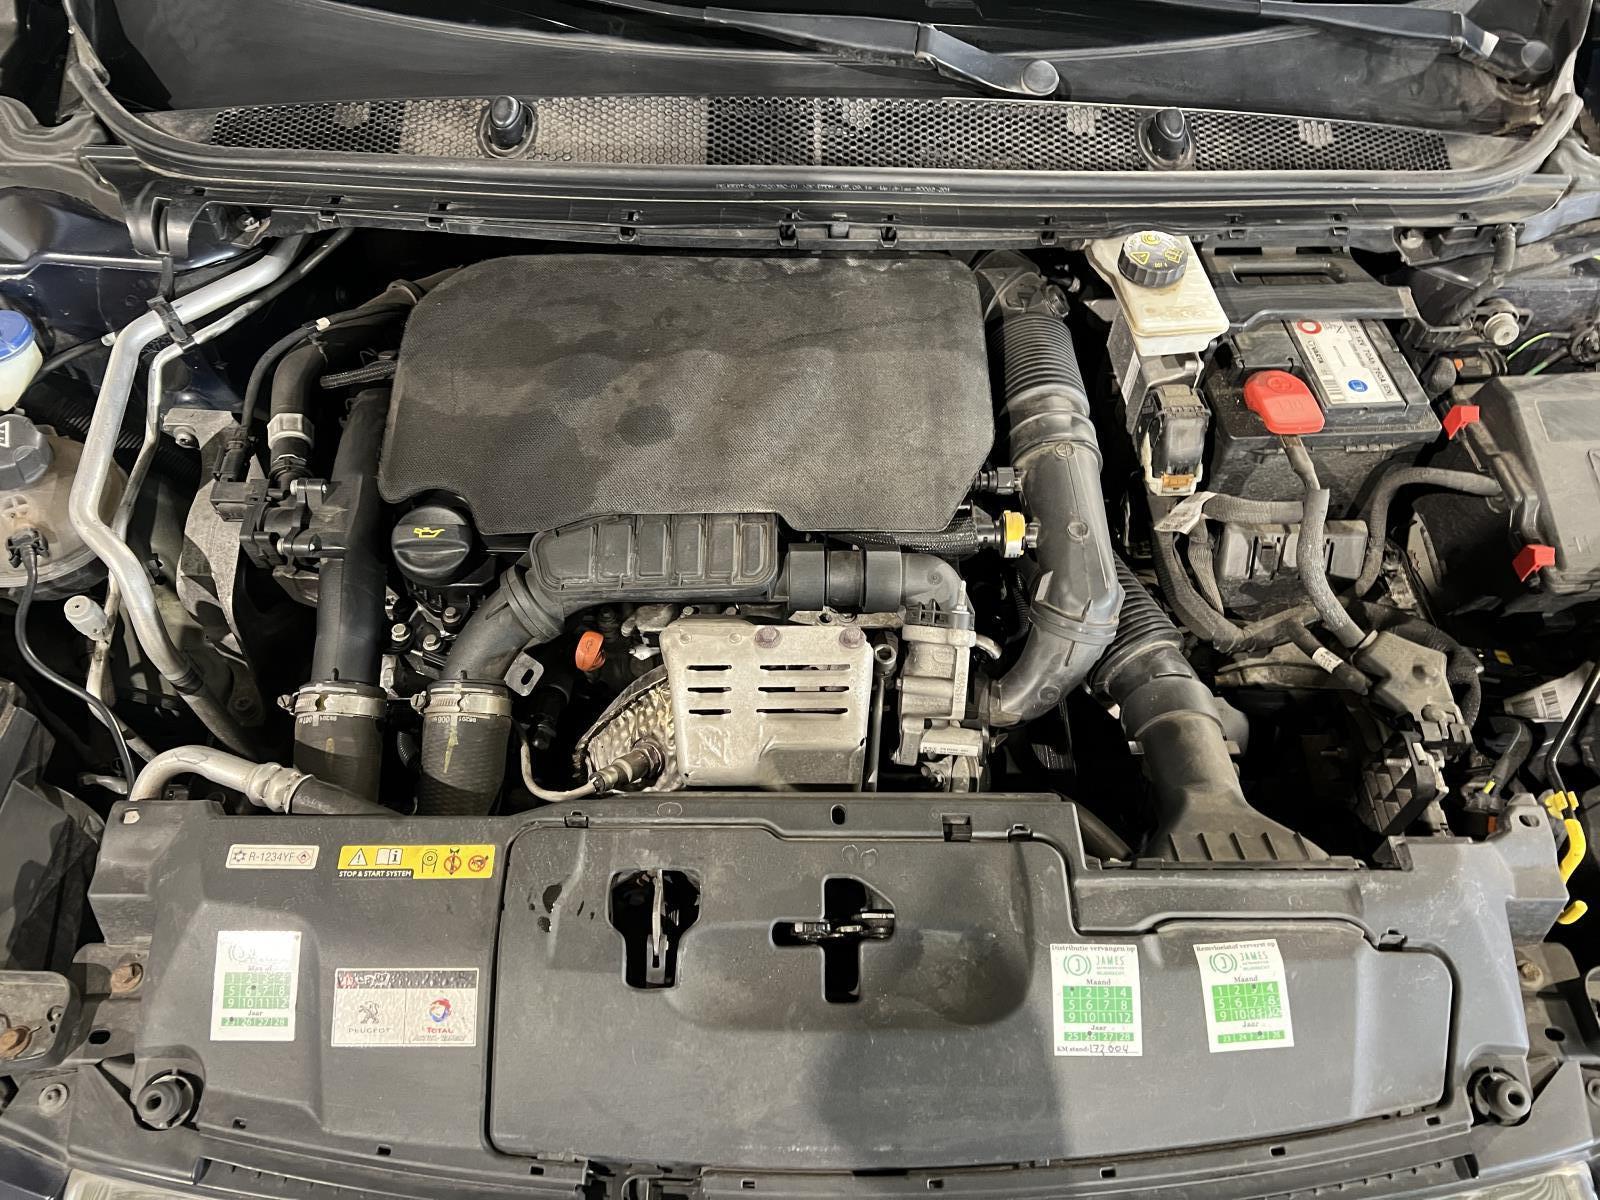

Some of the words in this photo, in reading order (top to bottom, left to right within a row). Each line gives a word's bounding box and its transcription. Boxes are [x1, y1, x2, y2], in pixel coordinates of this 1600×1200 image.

[249, 851, 295, 862] R-1234YF
[339, 870, 357, 878] STOP
[357, 870, 363, 878] &
[364, 870, 385, 878] START
[385, 870, 411, 878] SYSTEM
[1096, 955, 1125, 966] JAMES
[1240, 951, 1268, 961] JAMES
[229, 985, 235, 995] 5
[263, 985, 270, 995] 7
[279, 986, 285, 995] 8
[1086, 987, 1092, 998] 2
[1104, 987, 1110, 998] 3
[1120, 987, 1127, 998] 4
[1218, 986, 1223, 996] 1
[1234, 985, 1241, 995] 2
[1266, 983, 1274, 992] 4
[228, 998, 235, 1008] 9
[243, 998, 254, 1008] 10
[260, 998, 270, 1008] 11
[276, 998, 288, 1008] 12
[1069, 1000, 1076, 1010] 5
[1086, 1000, 1093, 1010] 6
[1104, 1000, 1110, 1010] 7
[1120, 1000, 1128, 1010] 8
[1218, 998, 1225, 1009] 5
[1235, 997, 1242, 1008] 6
[1252, 996, 1258, 1007] 7
[1068, 1012, 1076, 1022] 9
[1084, 1012, 1096, 1022] 10
[1101, 1012, 1113, 1022] 11
[1118, 1012, 1131, 1023] 12
[1220, 1010, 1227, 1021] 9
[1234, 1009, 1246, 1020] 10
[1069, 1033, 1079, 1041] 25
[1103, 1033, 1114, 1041] 27
[1120, 1033, 1131, 1041] 28
[1056, 1044, 1068, 1052] KM
